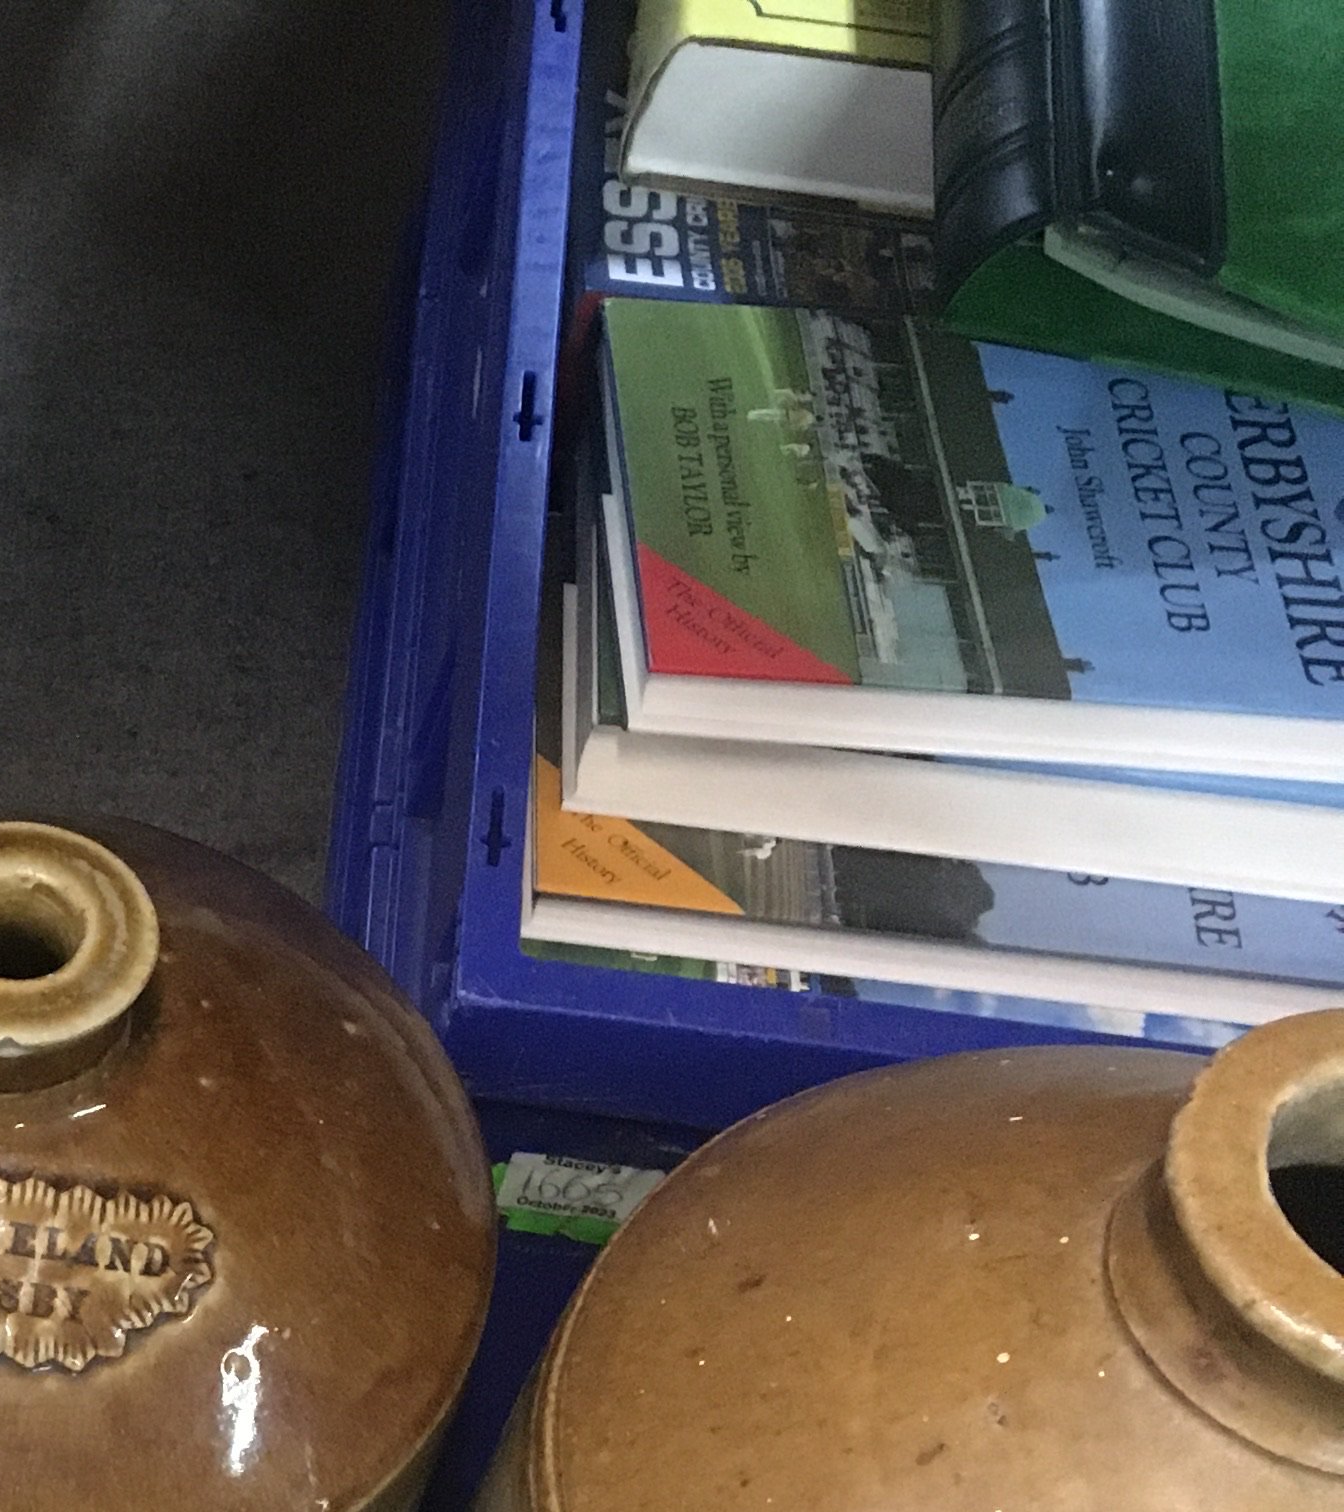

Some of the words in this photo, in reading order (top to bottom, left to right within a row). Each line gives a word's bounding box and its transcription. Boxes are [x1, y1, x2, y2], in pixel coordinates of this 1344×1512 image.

[687, 231, 717, 291] COUNTY
[670, 404, 701, 447] BOB
[707, 376, 737, 418] With
[711, 430, 750, 508] personal
[1056, 425, 1095, 470] John
[680, 451, 713, 538] TAYLOR
[1075, 475, 1123, 570] Shawcroft
[1107, 377, 1183, 531] CRICKET
[1147, 535, 1211, 633] CLUB
[1179, 431, 1260, 585] COUNTY
[726, 510, 752, 548] view
[1223, 388, 1344, 687] ERBYSHIRE
[731, 553, 759, 576] by
[561, 838, 622, 885] History
[572, 812, 604, 833] he
[607, 833, 672, 881] Official
